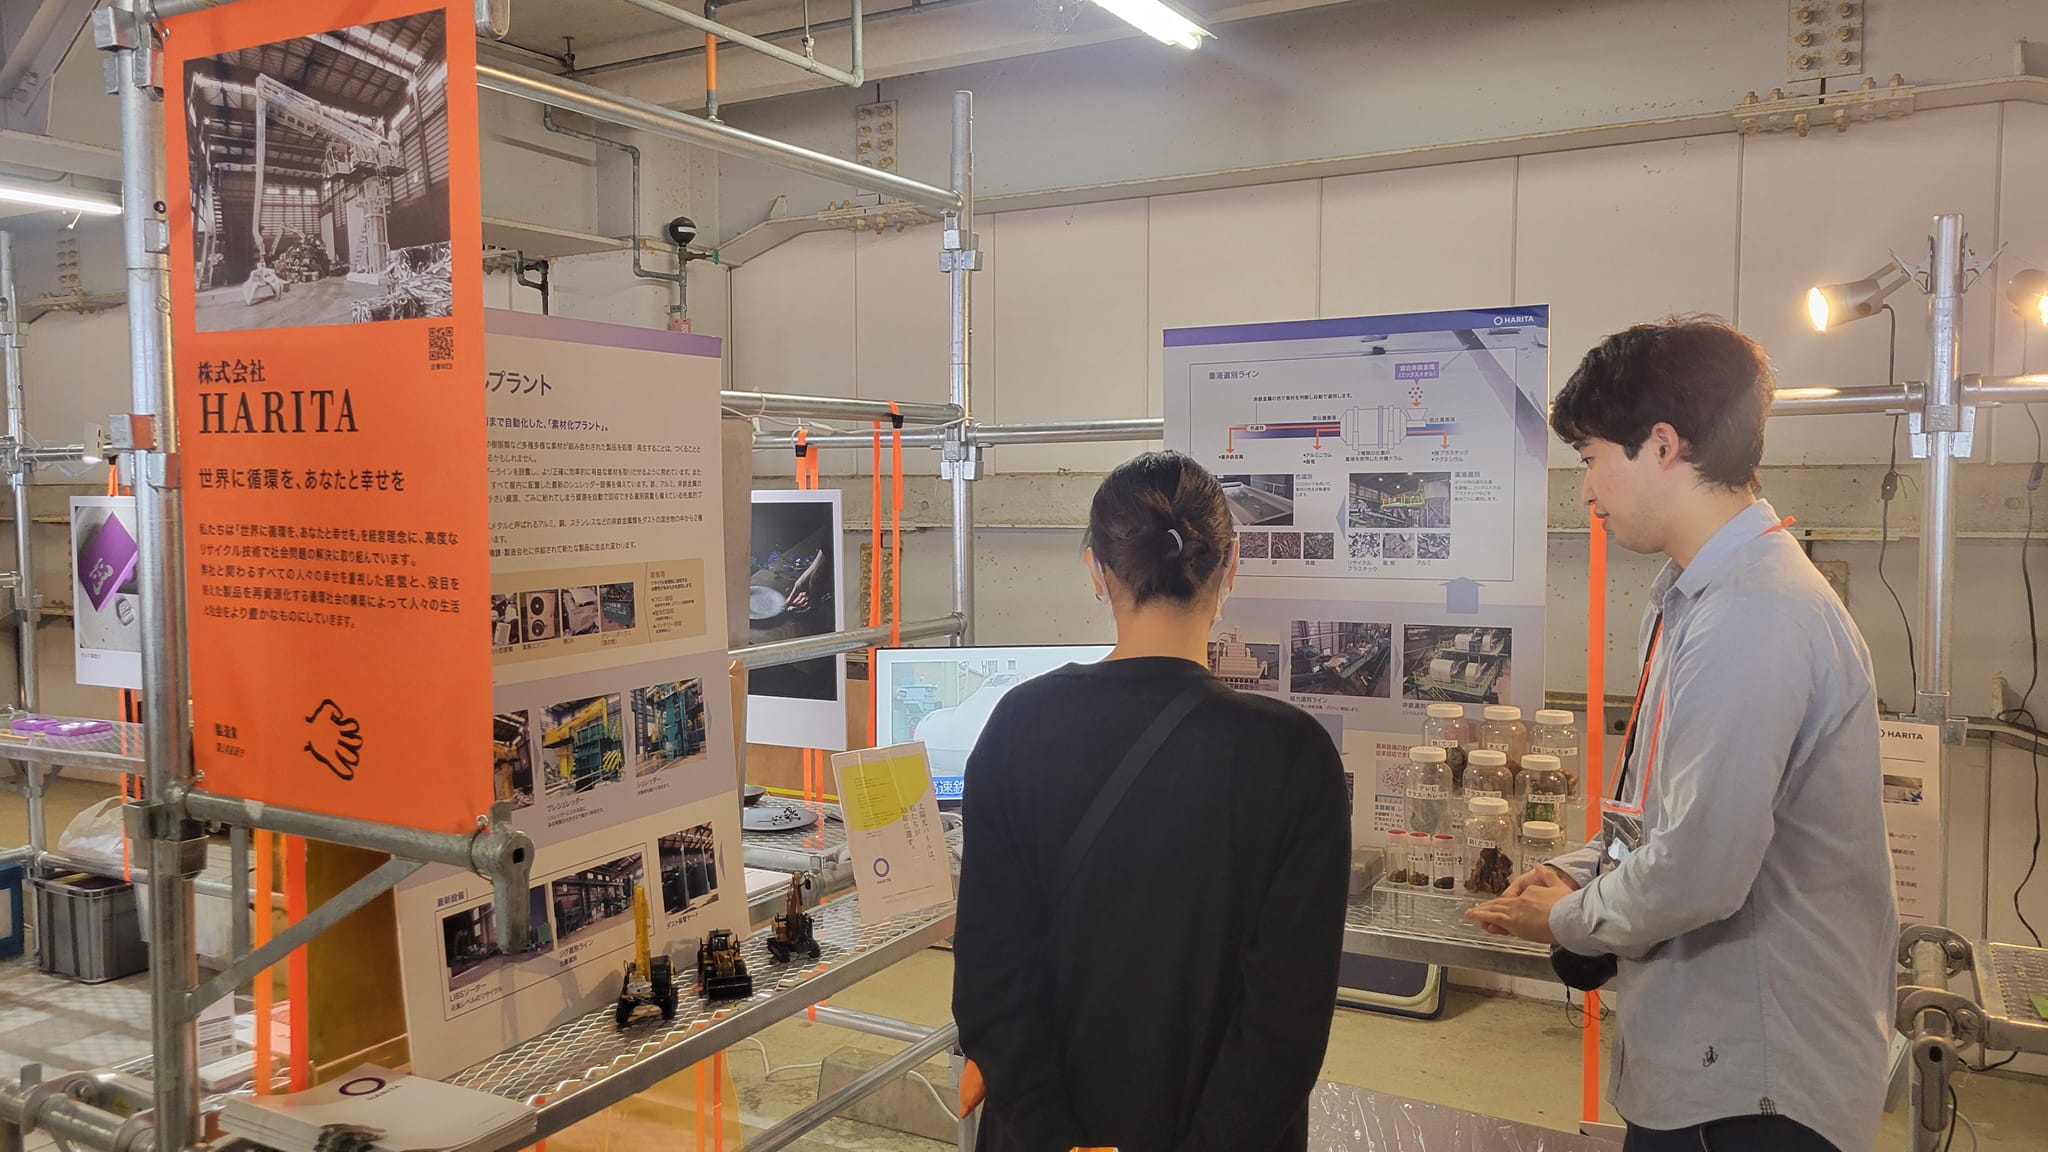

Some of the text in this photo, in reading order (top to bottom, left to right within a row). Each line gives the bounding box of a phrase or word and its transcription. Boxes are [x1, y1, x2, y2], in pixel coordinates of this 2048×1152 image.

[1504, 315, 1534, 324] HARITA
[198, 359, 266, 384] 株式会社
[485, 370, 552, 396] プラント
[199, 388, 359, 434] HARITA
[486, 415, 609, 432] まで自動化した、「素材化プラント」。
[199, 467, 406, 492] 世界に循環を、あなたと幸せを
[1887, 731, 1923, 740] HARITA
[546, 797, 585, 812] プレシュレッダー
[438, 891, 465, 907] 最新設備
